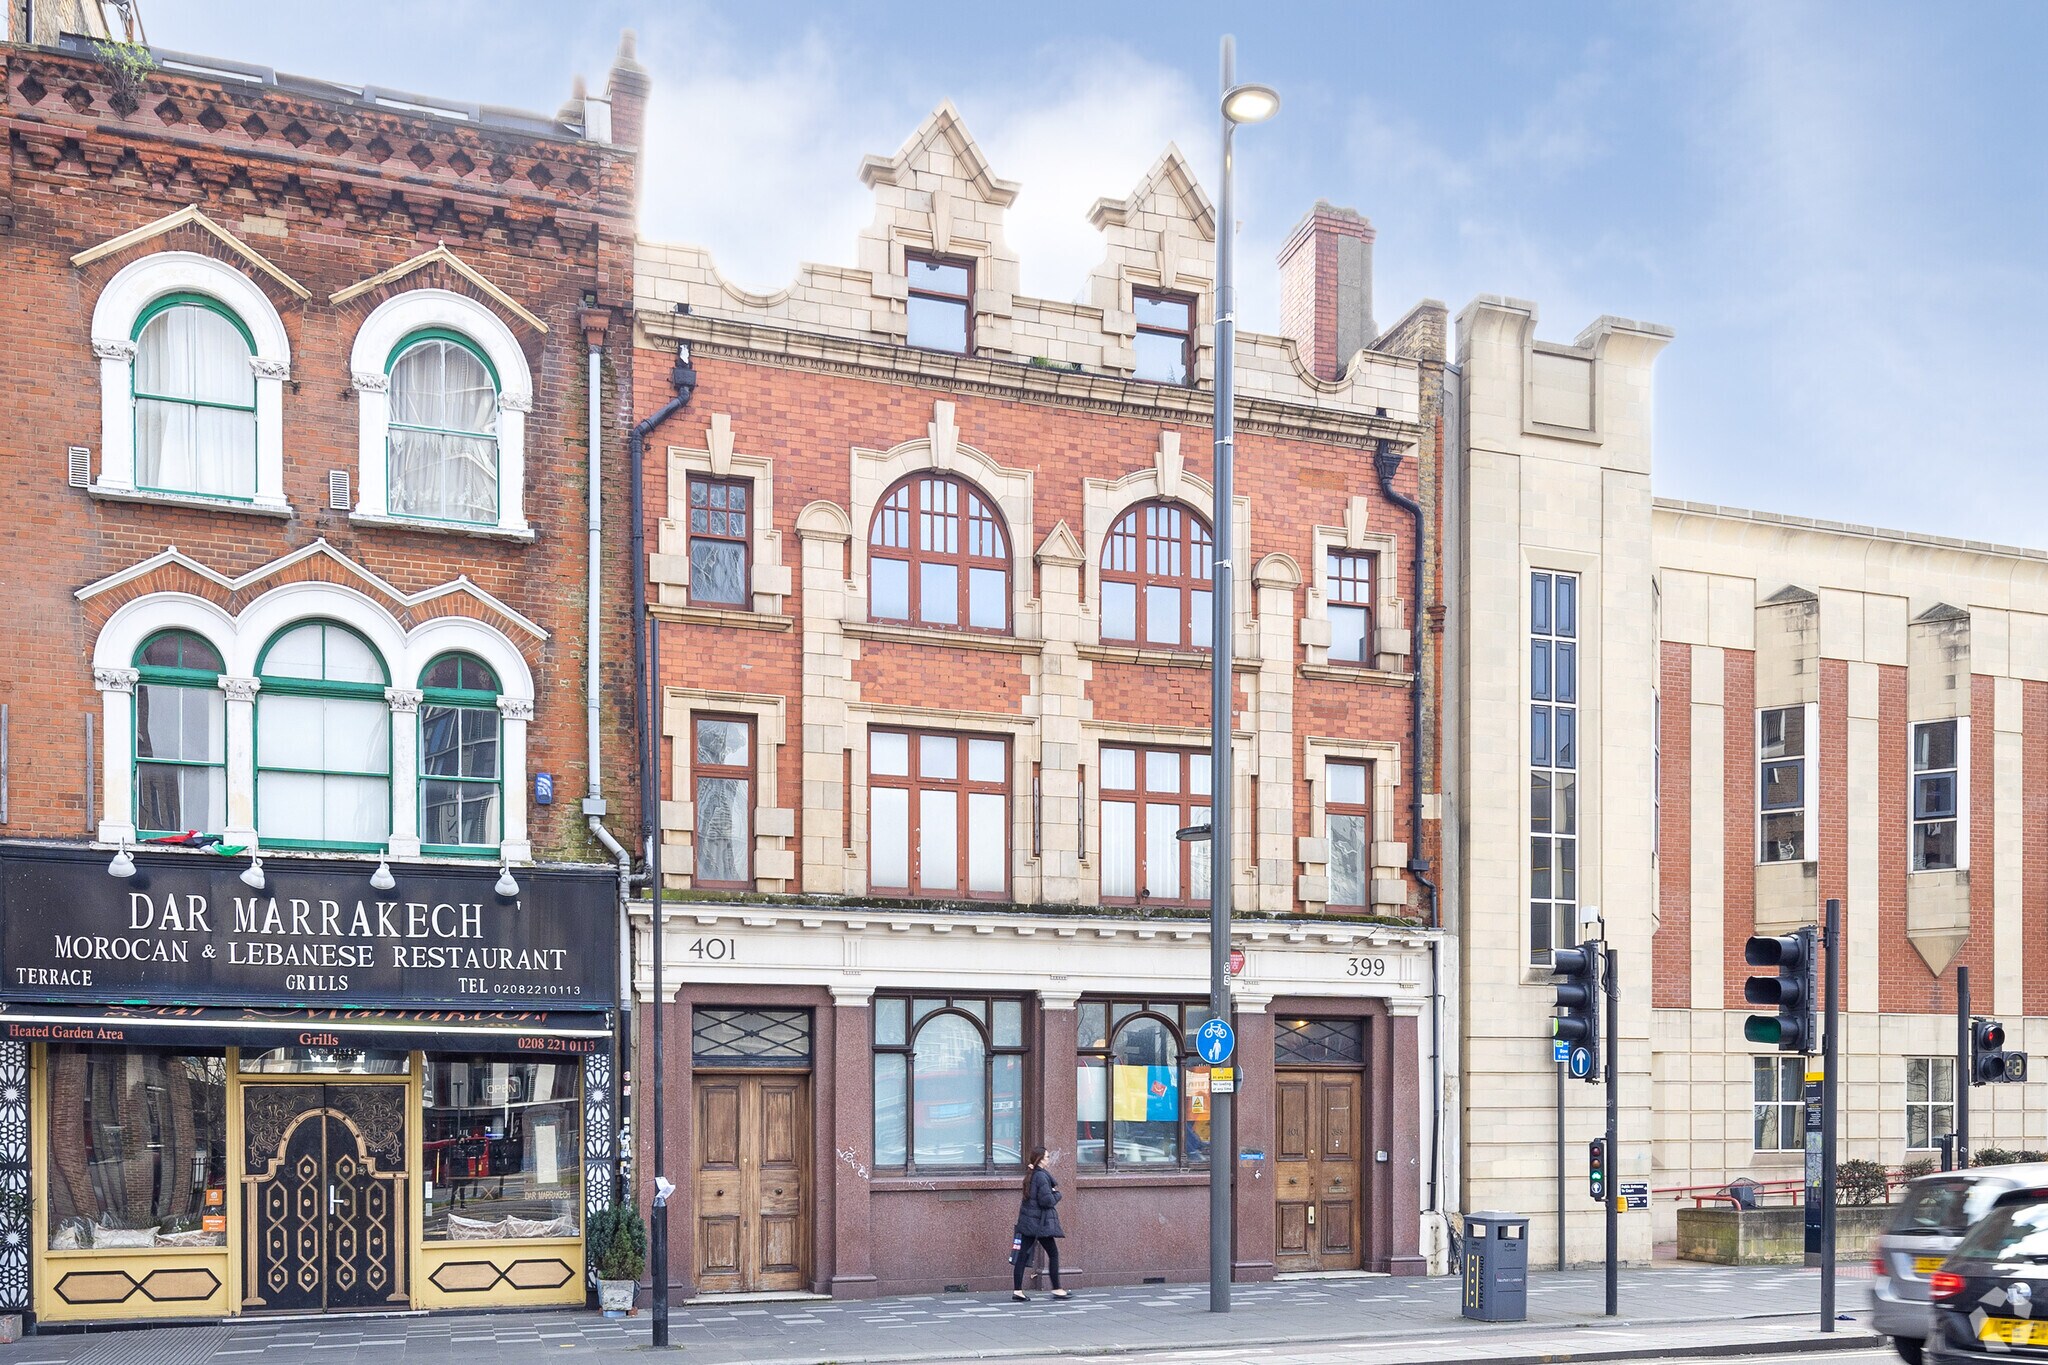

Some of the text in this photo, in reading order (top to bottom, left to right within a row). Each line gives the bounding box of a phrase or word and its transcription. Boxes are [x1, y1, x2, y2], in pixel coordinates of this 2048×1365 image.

[129, 893, 484, 938] DAR MARRAKECH
[55, 935, 566, 970] MOROCAN & LEBANESE RESTAURANT
[689, 938, 735, 959] 401
[1346, 957, 1385, 976] 399
[16, 968, 93, 986] TERRACE
[286, 974, 349, 991] GRILLS
[459, 977, 581, 995] TEL 02082210113
[9, 1024, 124, 1040] Heated Garden Area
[299, 1032, 339, 1046] Grills
[518, 1037, 595, 1053] 0208 221 0113
[486, 1083, 517, 1094] OPEN
[525, 1192, 537, 1200] DAR
